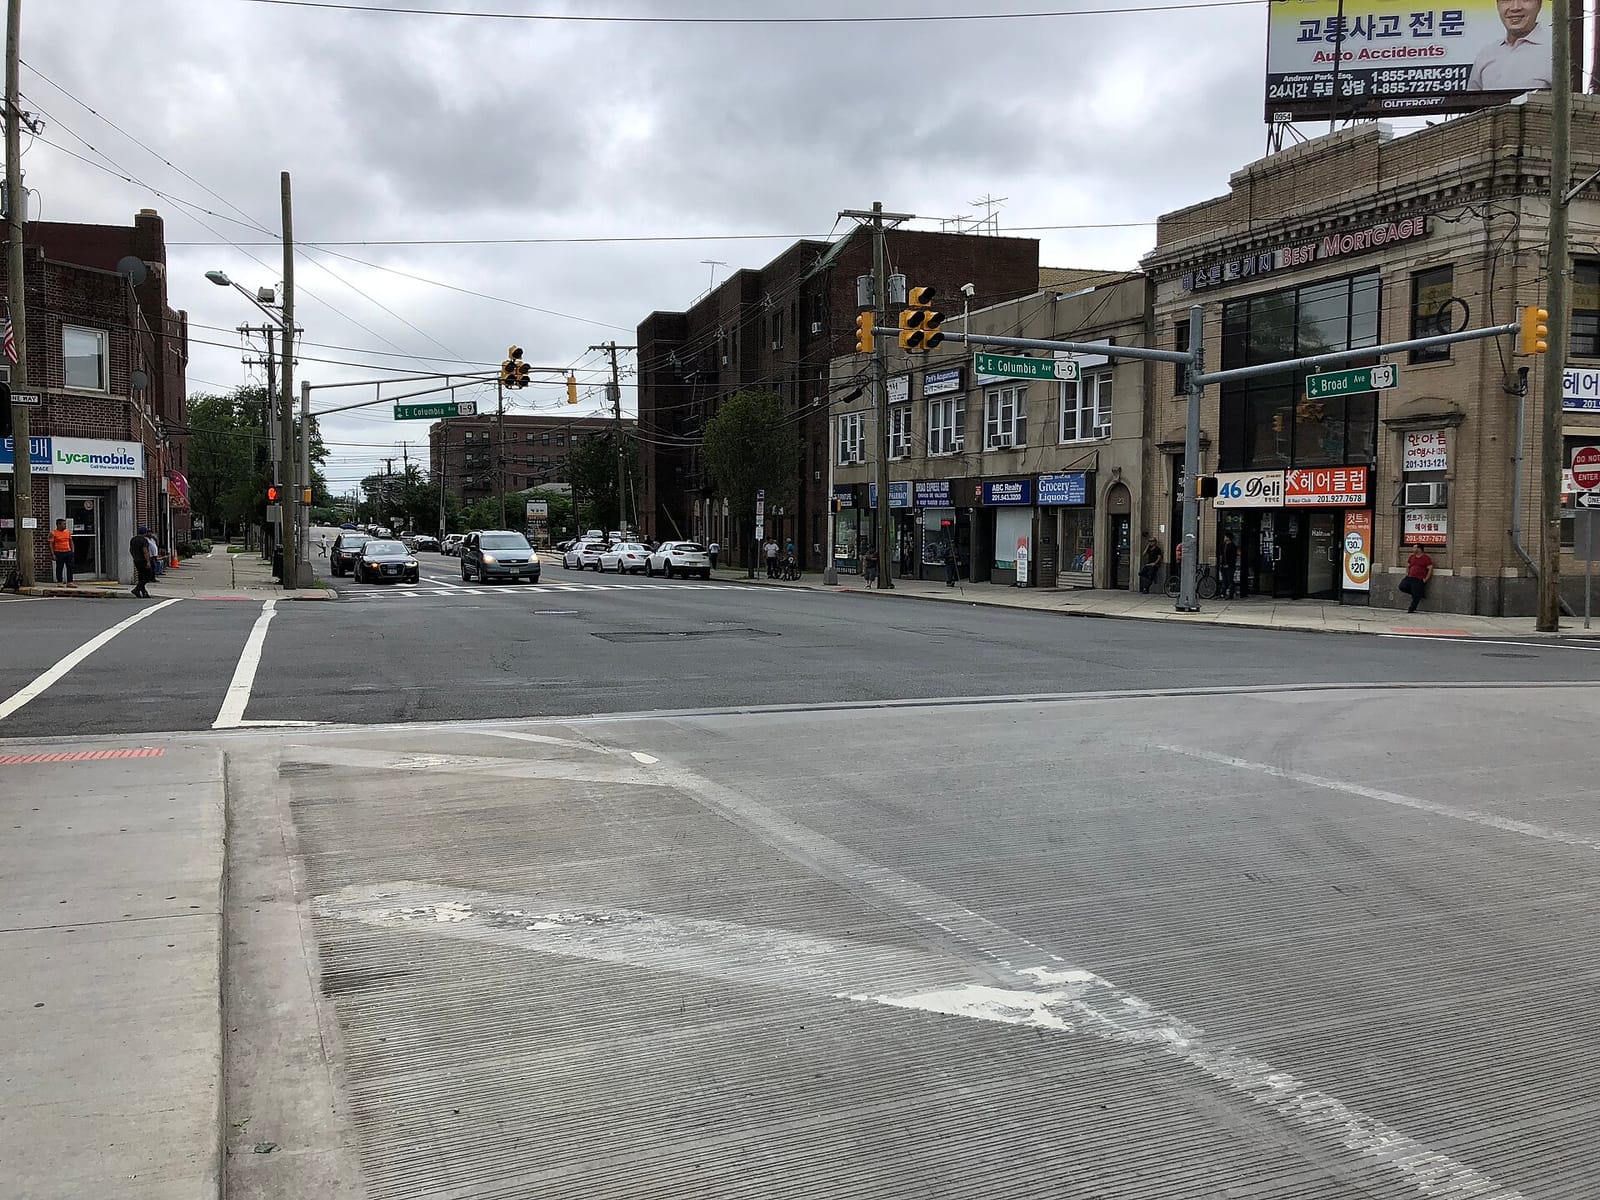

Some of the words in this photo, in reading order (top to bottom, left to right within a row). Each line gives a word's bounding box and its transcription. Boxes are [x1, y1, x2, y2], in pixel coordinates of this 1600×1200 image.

[1297, 14, 1402, 42] 교통사고
[1409, 10, 1464, 37] 전문
[1312, 51, 1353, 62] Auto
[1358, 45, 1444, 60] Accidents
[1337, 72, 1353, 80] Esq.
[1371, 67, 1467, 82] 1-855-PARK-911
[1269, 83, 1308, 98] 24시간
[1340, 80, 1366, 96] 상담
[1371, 80, 1467, 95] 1-855-7275-911
[1282, 244, 1316, 267] BEST
[1323, 216, 1424, 258] MORTGAGE
[998, 360, 1037, 374] Columbia
[1042, 363, 1052, 371] Ave
[1057, 363, 1074, 376] 1-9
[1312, 378, 1317, 386] S
[1321, 377, 1348, 391] Broad
[1353, 375, 1366, 384] Ave
[1373, 370, 1391, 384] 1-9
[1563, 371, 1599, 396] 헤어
[414, 407, 444, 416] Columbia
[57, 449, 135, 465] Lycamobile
[1300, 470, 1364, 492] 헤어클럽
[1578, 473, 1599, 481] ENTER
[992, 484, 1004, 492] ABC
[1005, 483, 1022, 492] Realty
[1039, 480, 1070, 494] Grocery
[1219, 480, 1242, 498] 46
[1245, 477, 1280, 498] Deli
[1039, 493, 1069, 503] Liquors
